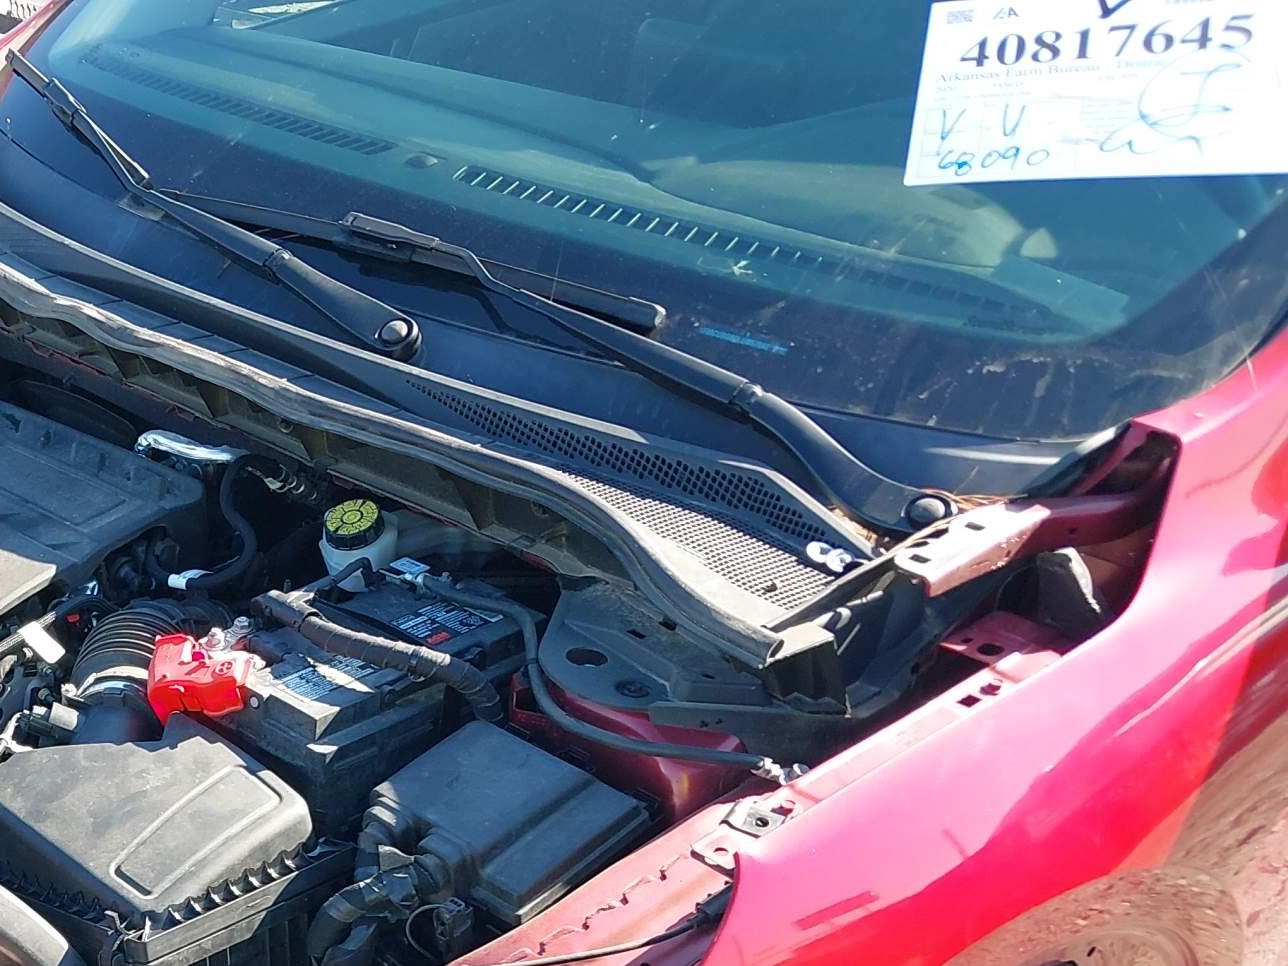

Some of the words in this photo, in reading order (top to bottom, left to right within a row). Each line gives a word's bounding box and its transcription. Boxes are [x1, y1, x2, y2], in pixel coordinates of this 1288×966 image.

[960, 14, 1255, 67] 40817645
[936, 71, 1000, 83] Arkansas
[1005, 68, 1043, 79] Farm
[1048, 63, 1101, 75] Bureau
